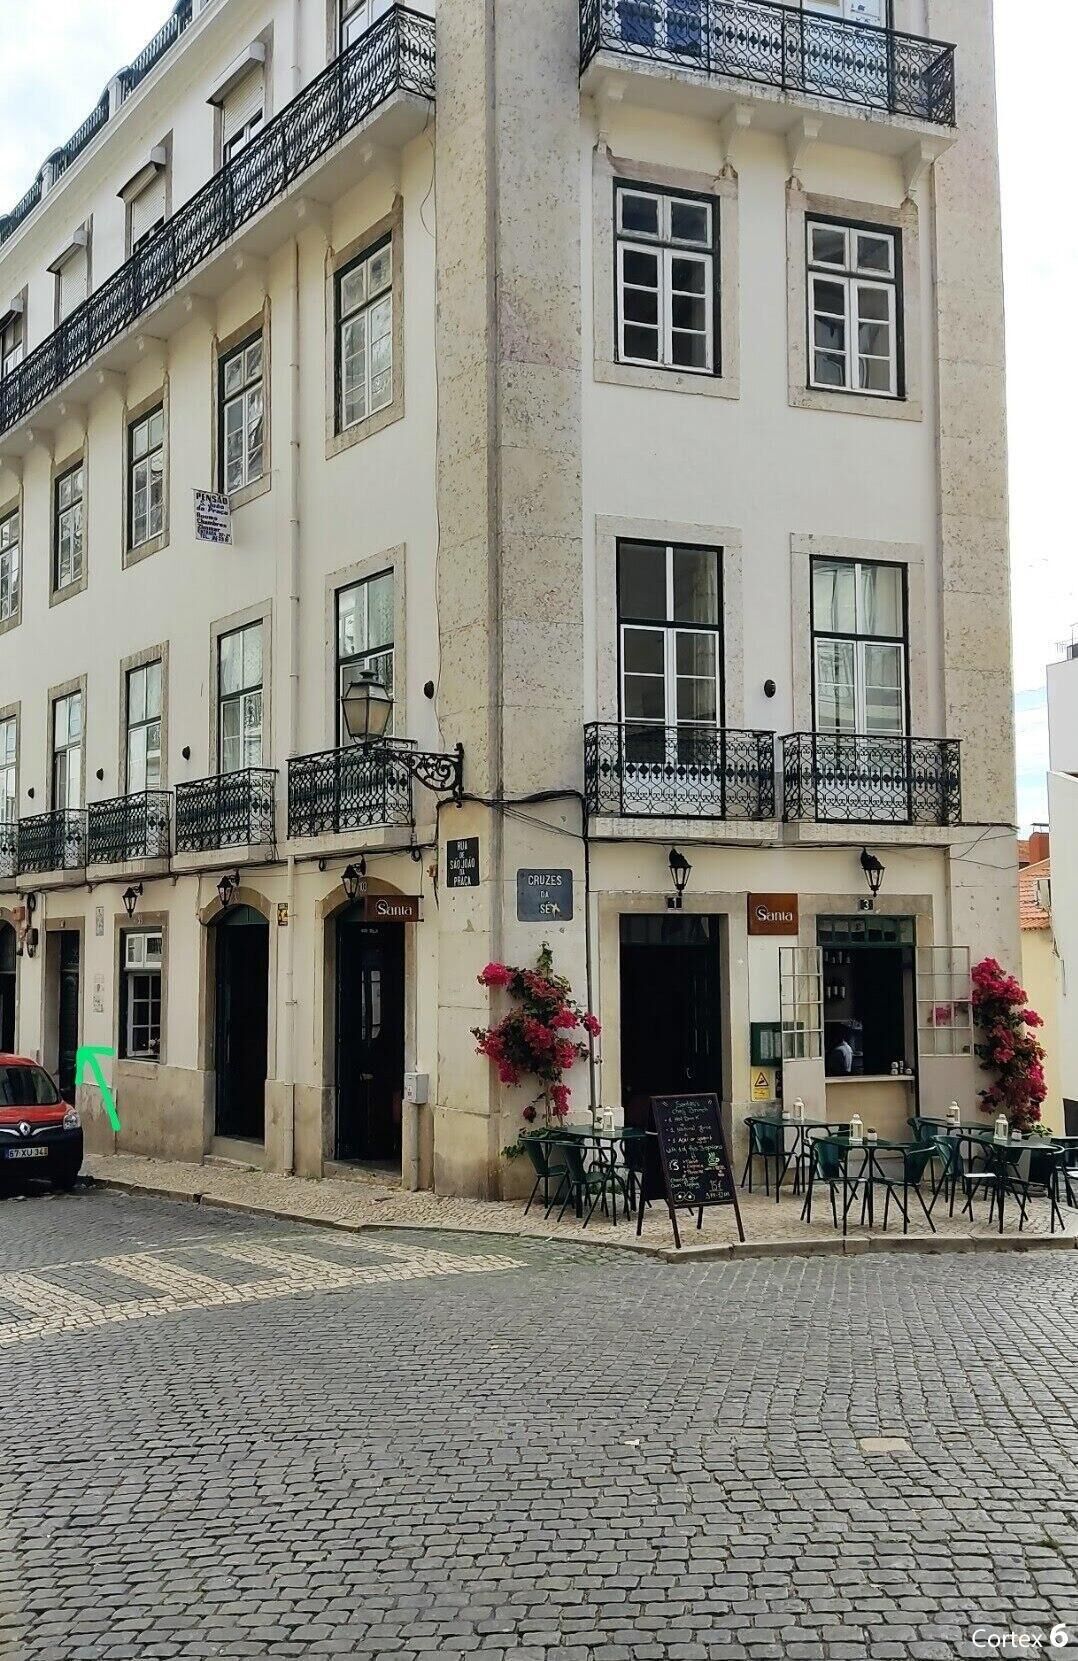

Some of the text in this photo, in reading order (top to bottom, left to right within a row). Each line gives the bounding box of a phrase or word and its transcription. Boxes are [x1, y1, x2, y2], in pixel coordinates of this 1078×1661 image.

[457, 841, 468, 850] RUA
[450, 856, 476, 869] SÃO JOÃO
[528, 874, 562, 886] CRUZES
[540, 890, 550, 898] DA
[376, 899, 412, 916] Santa
[540, 901, 550, 914] SÉ
[863, 899, 870, 910] 3
[756, 904, 793, 921] Santa
